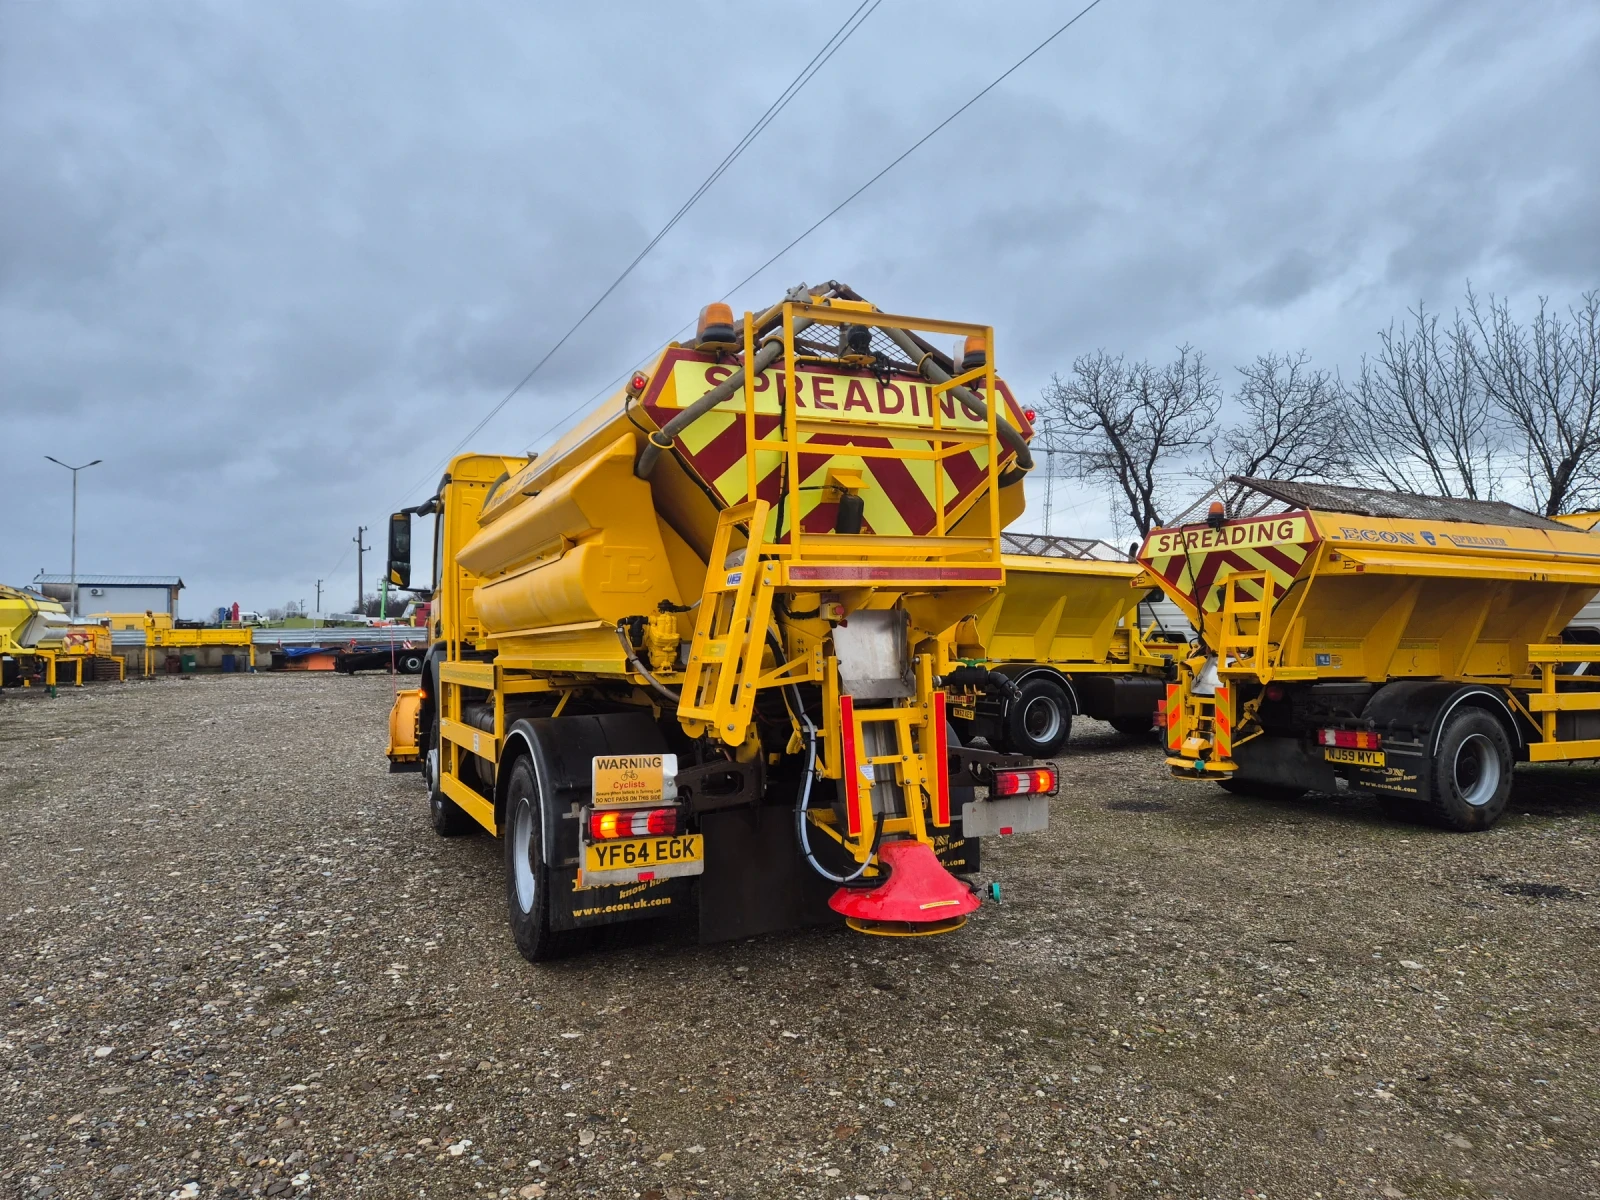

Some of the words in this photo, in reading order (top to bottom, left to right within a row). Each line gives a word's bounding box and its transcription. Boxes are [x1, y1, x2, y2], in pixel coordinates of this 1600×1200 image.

[703, 365, 987, 422] SPREADING
[1157, 520, 1294, 553] SPREADING
[1339, 526, 1418, 545] ECON
[1451, 534, 1509, 547] SPREADER
[597, 757, 662, 770] WARNING
[1328, 749, 1355, 761] NJ59
[1357, 751, 1380, 764] MYL
[613, 781, 646, 790] Cyclists
[1359, 780, 1418, 793] www.econ.uk.com
[595, 843, 650, 867] YF64
[655, 838, 695, 861] EGK
[619, 883, 647, 899] know
[572, 897, 672, 917] www.econ.uk.com
